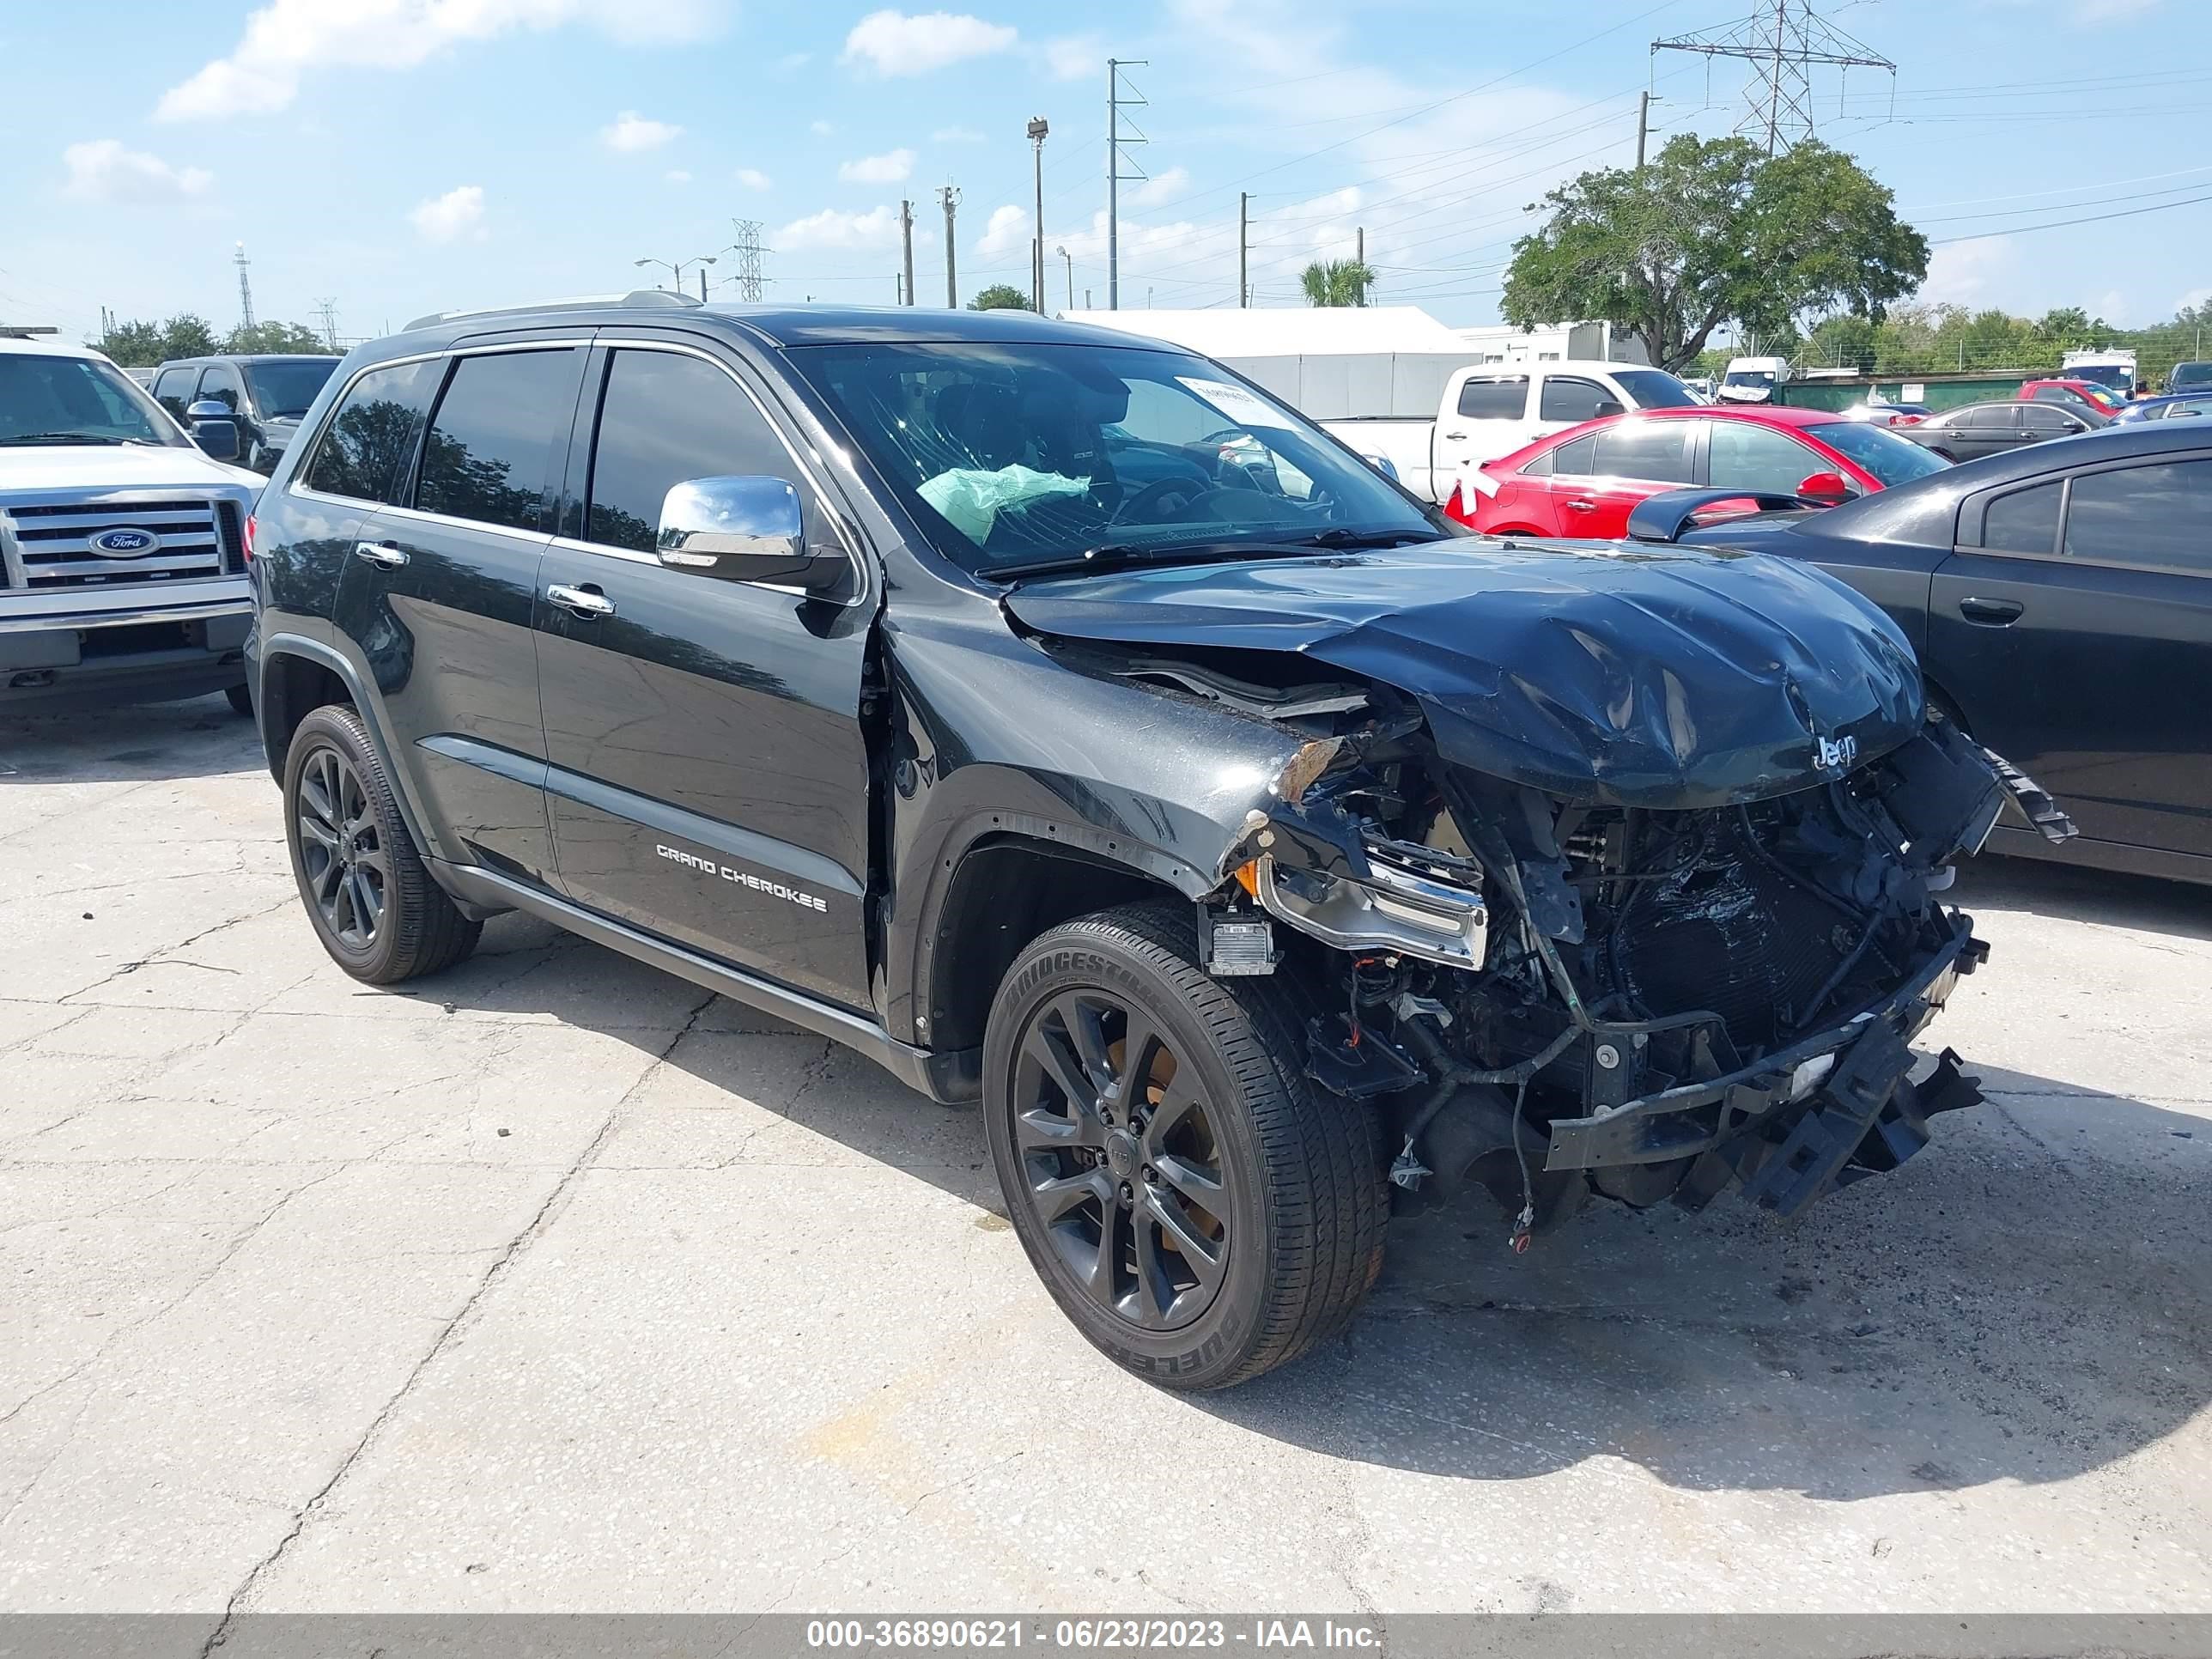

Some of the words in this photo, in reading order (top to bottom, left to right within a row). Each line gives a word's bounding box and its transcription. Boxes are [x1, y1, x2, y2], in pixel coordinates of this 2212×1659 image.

[111, 535, 142, 548] Ford
[1812, 735, 1857, 770] Jeep
[656, 844, 717, 875] GRAND
[720, 866, 829, 914] CHEROKEE
